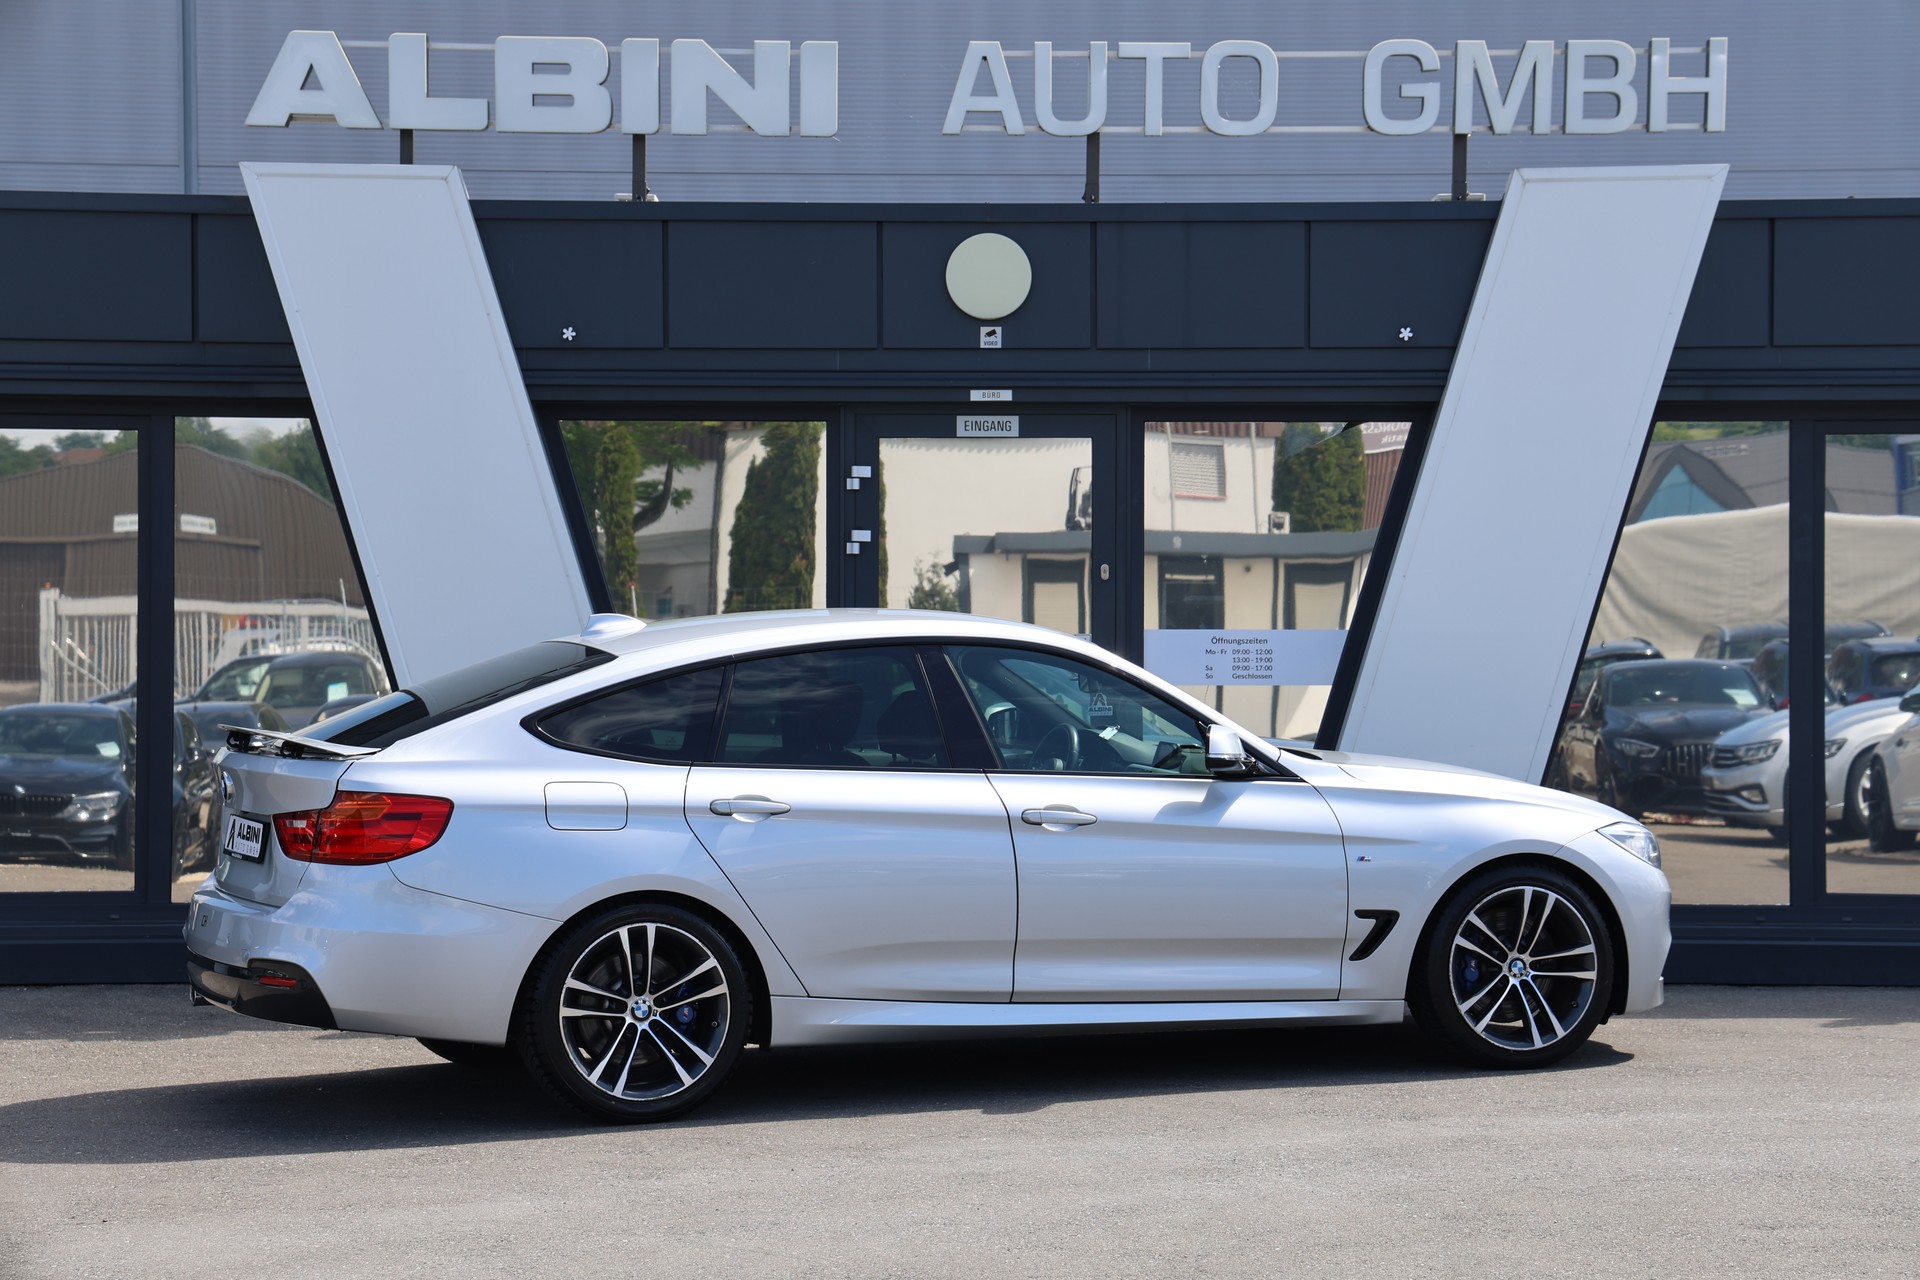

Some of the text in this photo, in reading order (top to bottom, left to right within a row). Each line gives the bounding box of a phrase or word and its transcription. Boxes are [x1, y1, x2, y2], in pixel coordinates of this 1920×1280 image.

[245, 30, 1729, 137] ALBINI AUTO GMBH
[964, 420, 1012, 432] EINGANG
[1211, 636, 1268, 645] Öffnungszeiten
[237, 822, 261, 844] ALBINI
